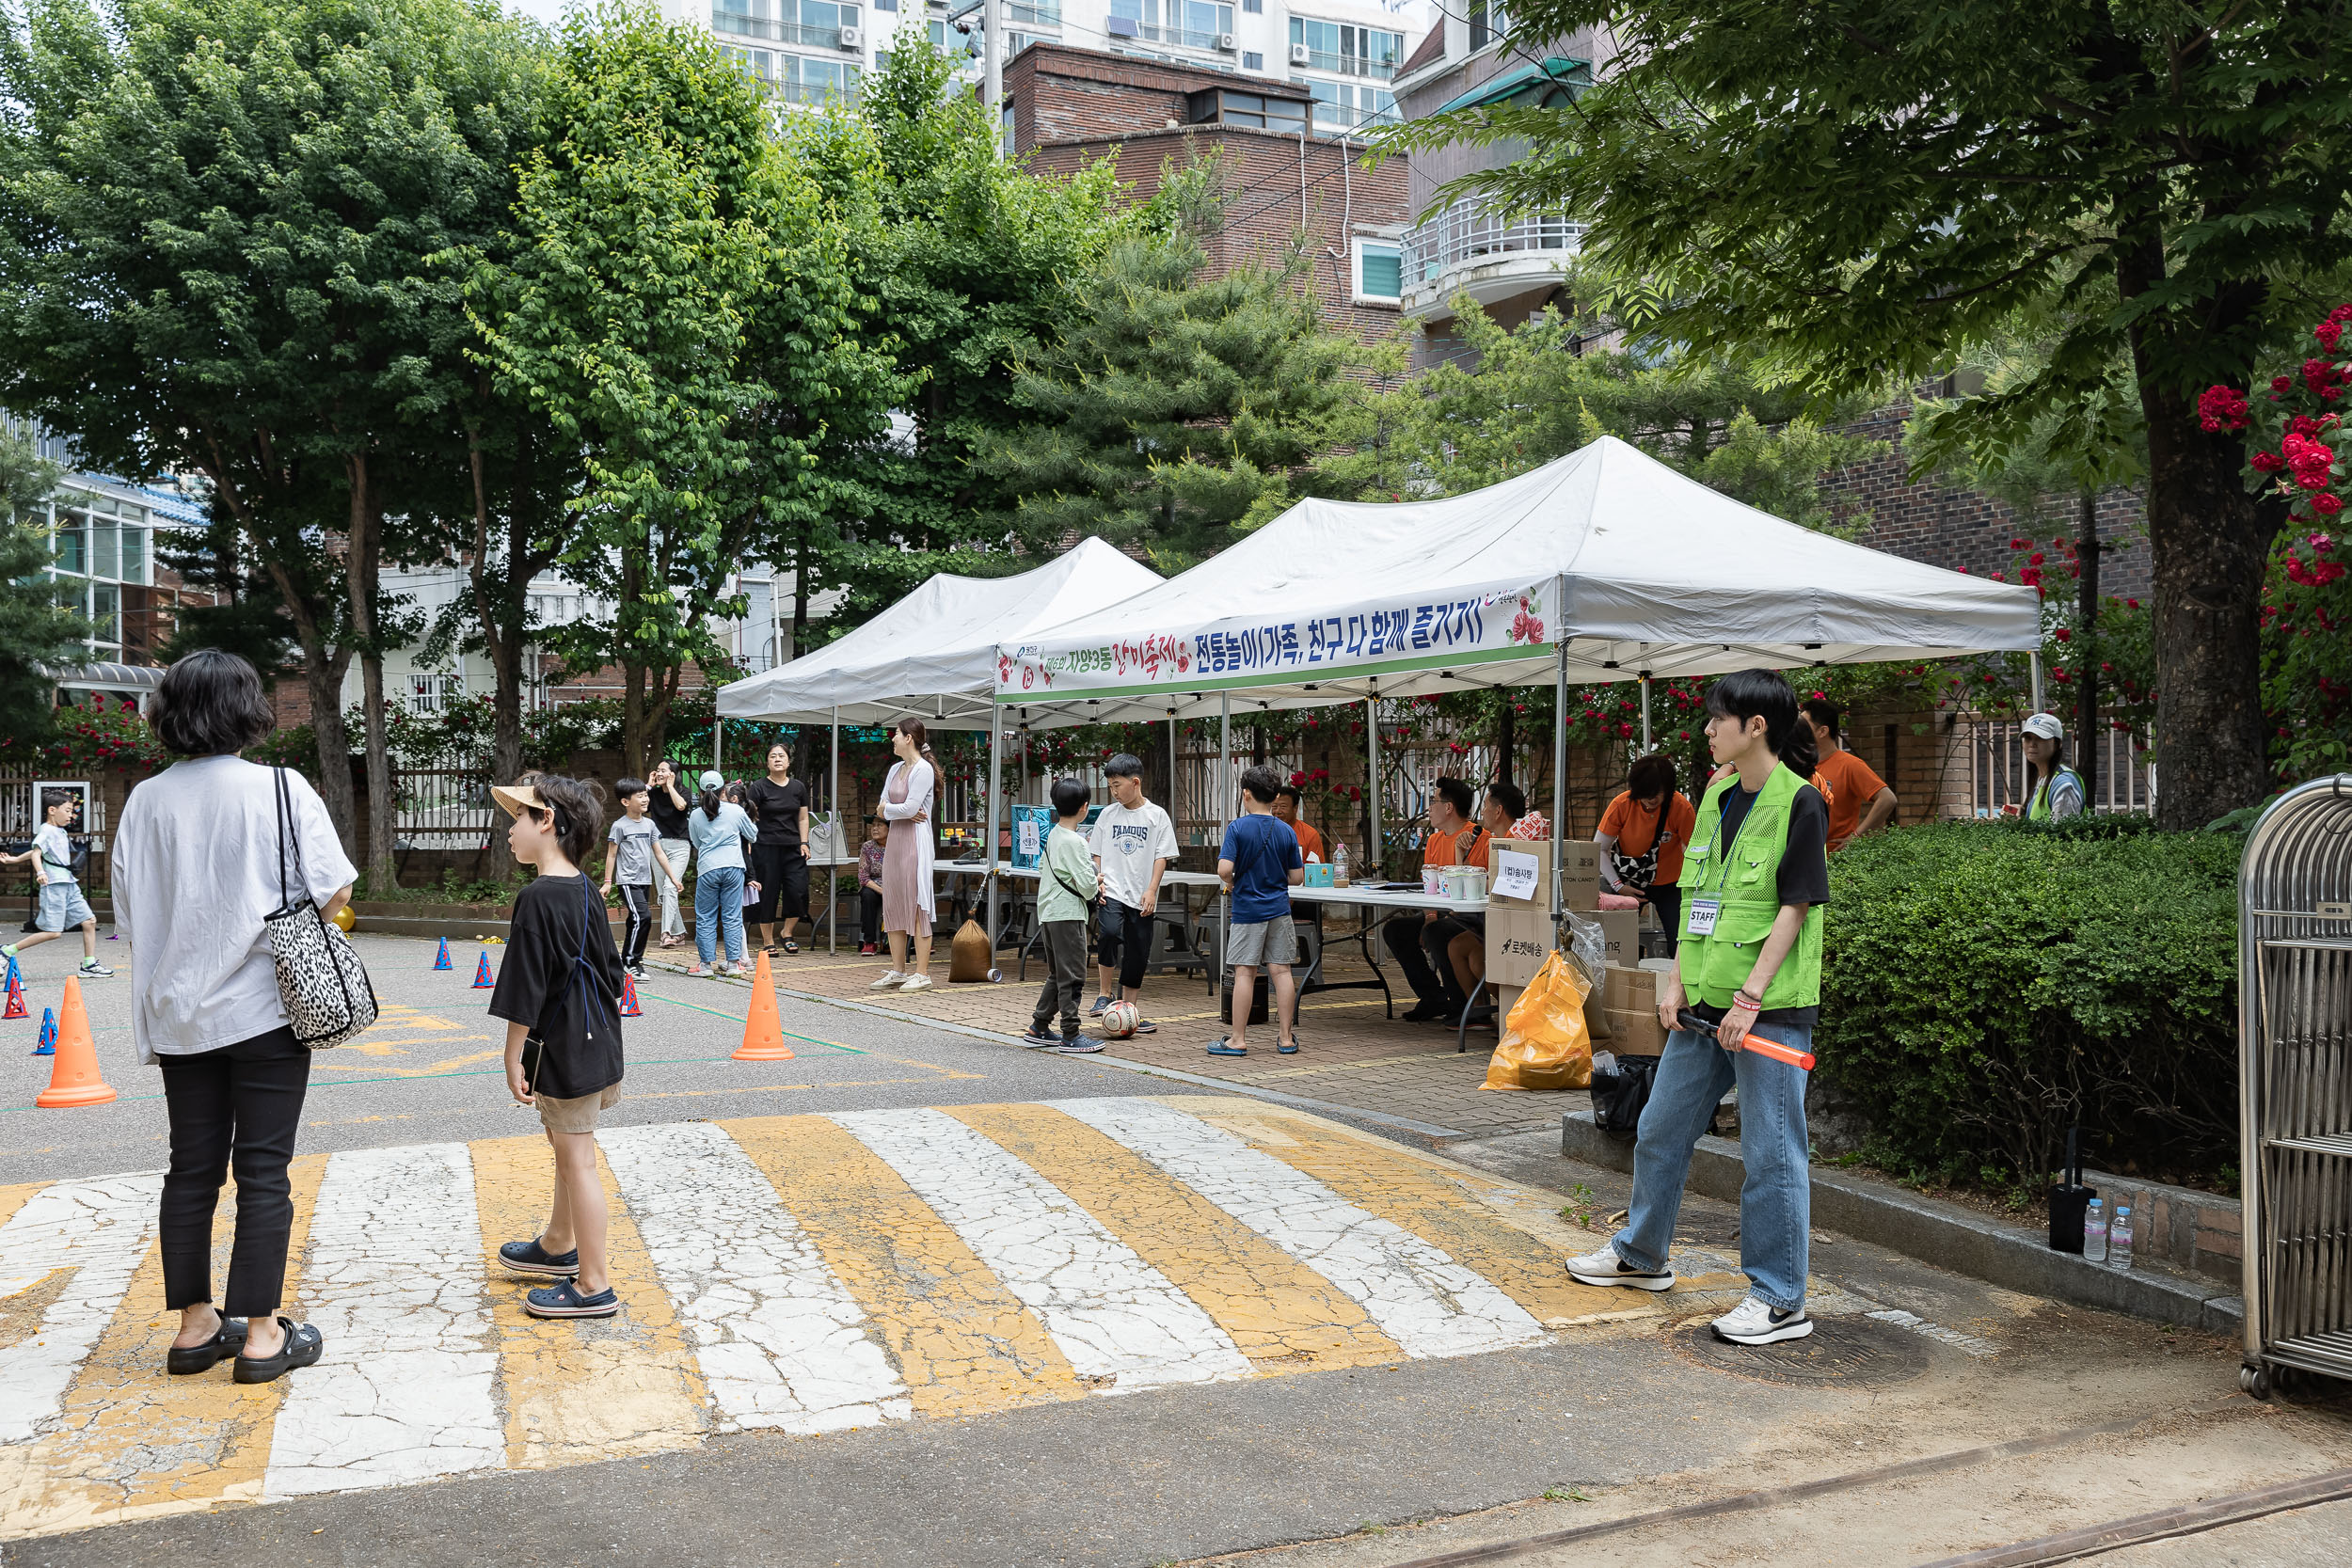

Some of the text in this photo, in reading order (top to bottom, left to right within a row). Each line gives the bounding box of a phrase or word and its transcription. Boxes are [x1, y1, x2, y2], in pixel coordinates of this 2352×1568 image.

[1045, 656, 1066, 671] 제6회
[1066, 647, 1112, 673] 자양3동
[1112, 633, 1176, 680] 장미축제
[1411, 596, 1483, 649] 즐기기)
[1112, 825, 1148, 840] FAMOUS
[1691, 911, 1715, 922] STAFF
[1511, 941, 1542, 957] 로켓배송
